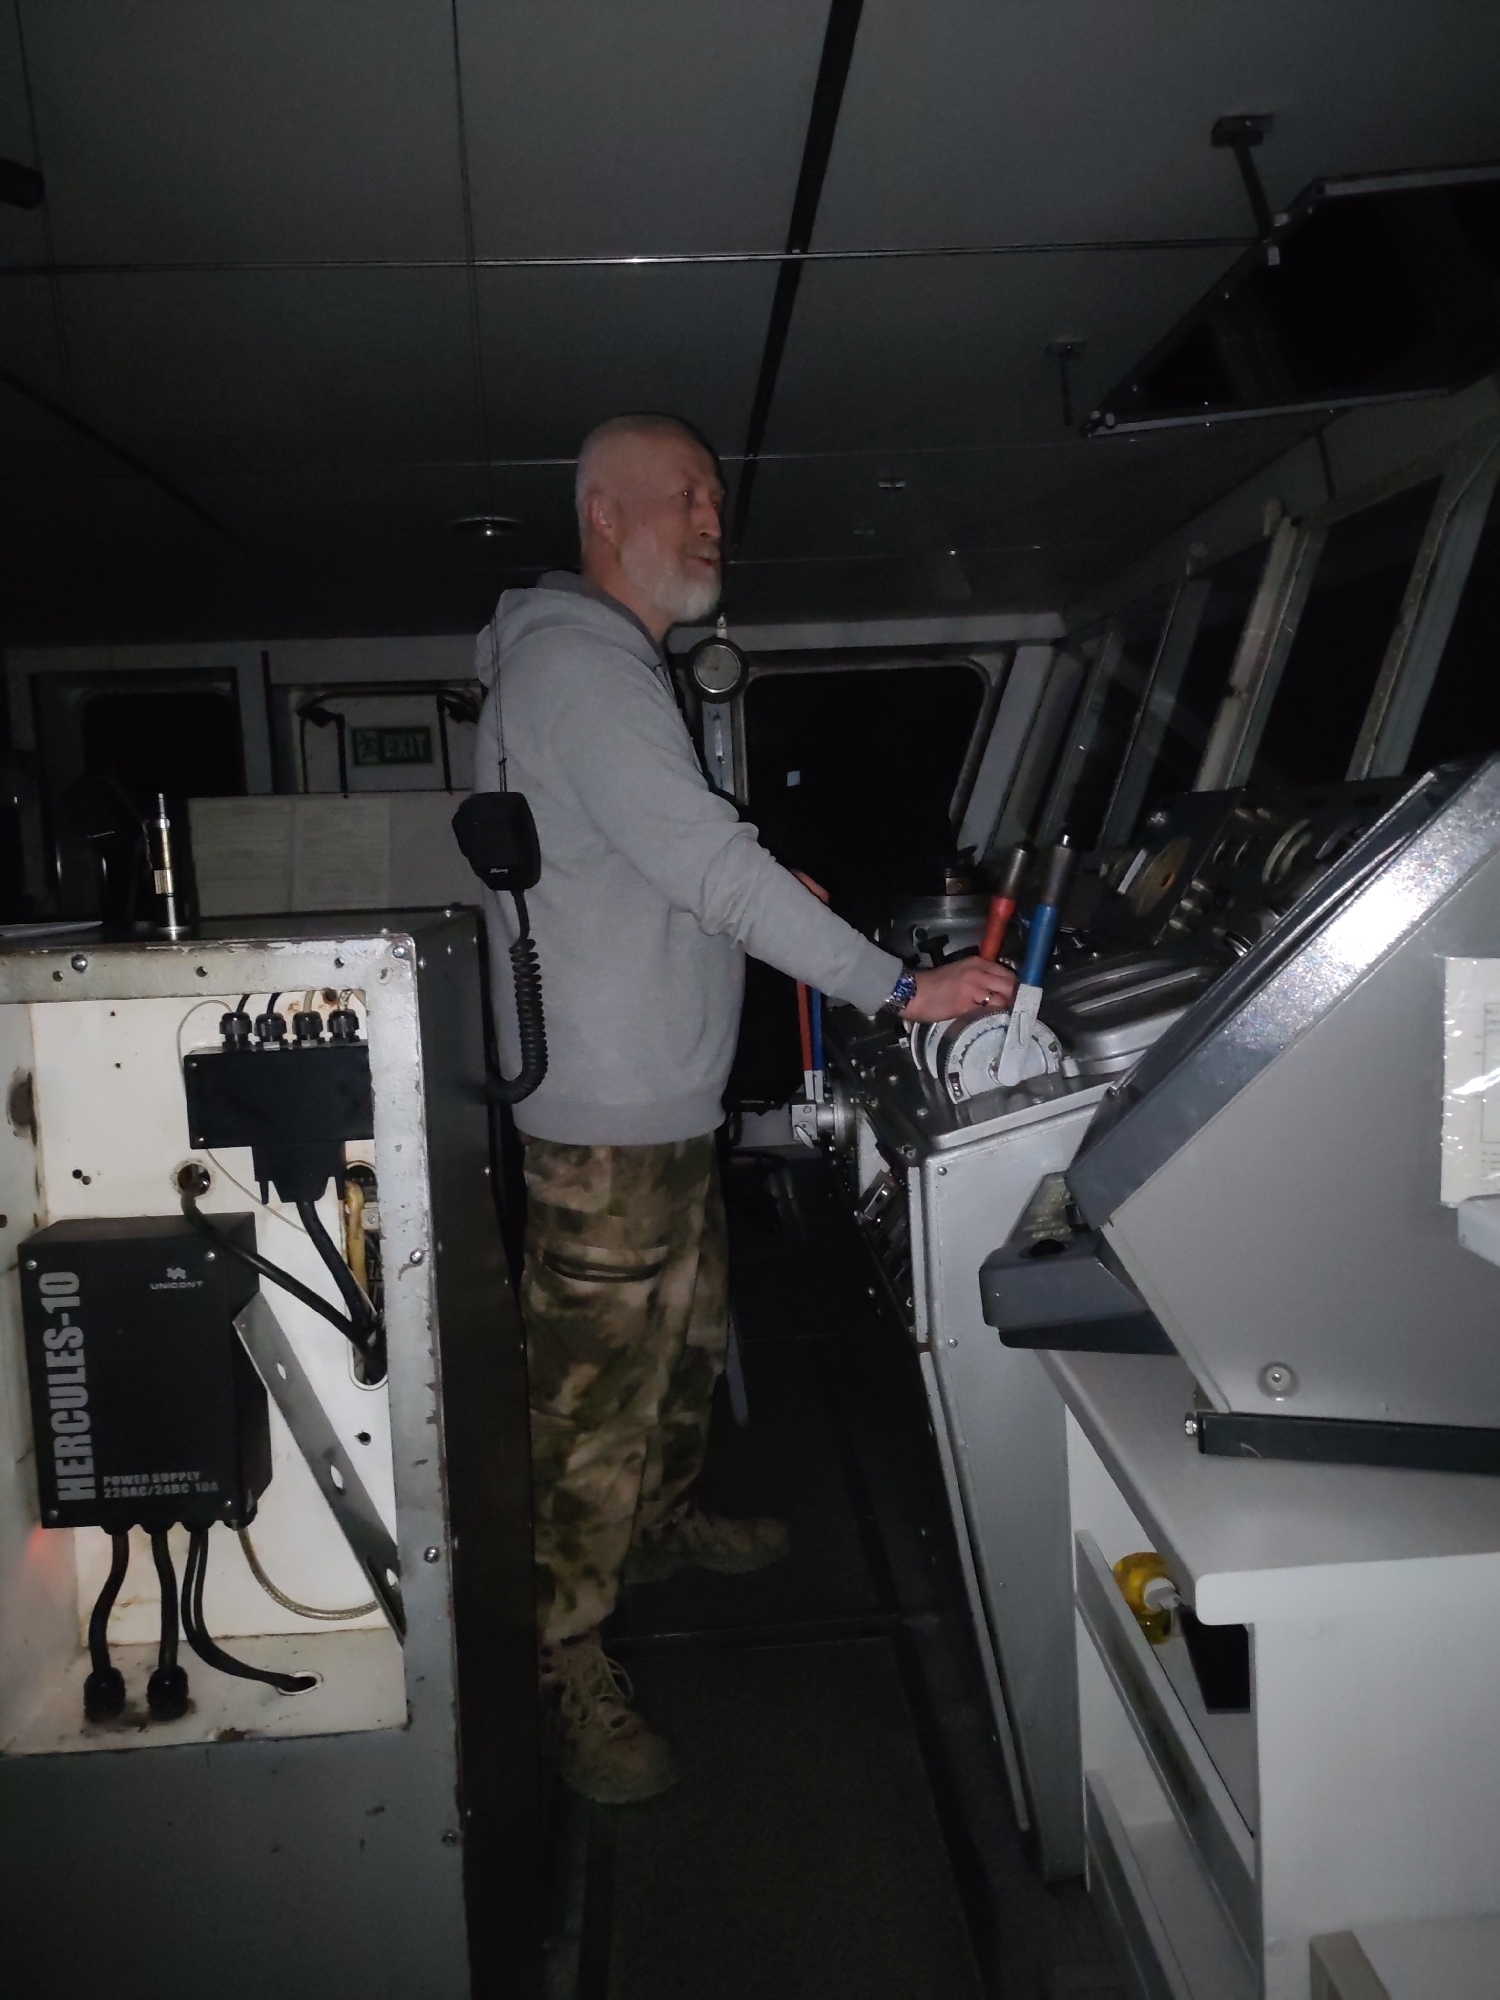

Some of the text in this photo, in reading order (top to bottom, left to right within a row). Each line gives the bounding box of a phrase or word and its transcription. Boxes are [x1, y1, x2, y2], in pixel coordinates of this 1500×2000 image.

[383, 733, 427, 758] EXIT
[150, 1280, 203, 1290] UNICONT
[38, 1271, 96, 1500] HERCULES-10
[103, 1471, 200, 1486] POWER SUPPLY
